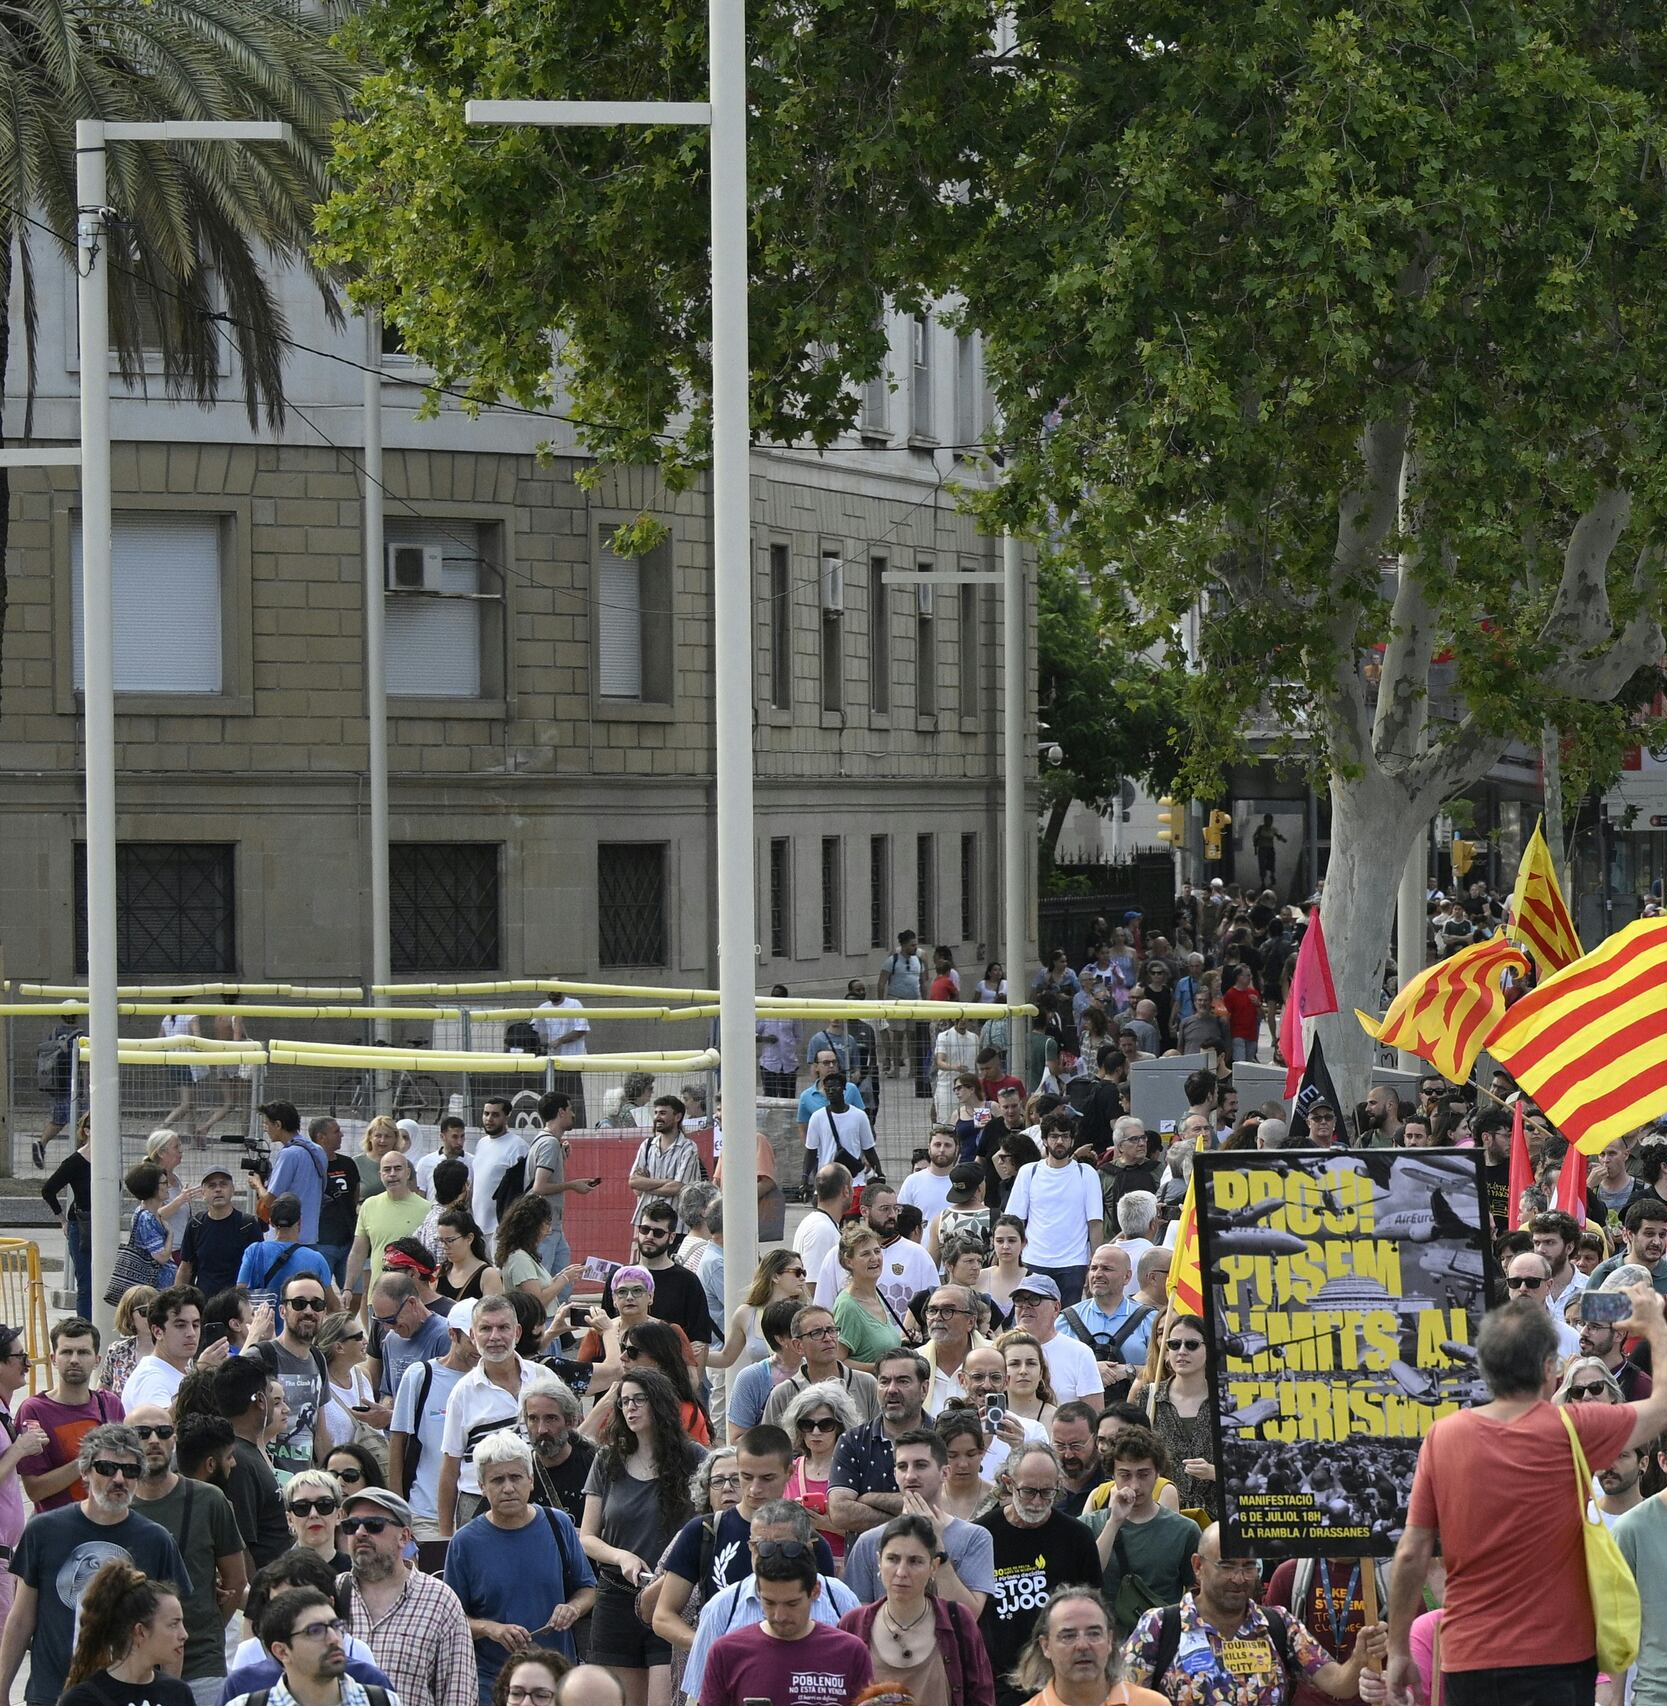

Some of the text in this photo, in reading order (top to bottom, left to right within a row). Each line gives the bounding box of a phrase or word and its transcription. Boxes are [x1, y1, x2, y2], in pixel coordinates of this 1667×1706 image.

[1238, 1492, 1314, 1507] MANIFESTACIÓ
[1239, 1511, 1322, 1523] 6 DE JULIOL 18H
[1241, 1527, 1254, 1539] LA
[1256, 1527, 1301, 1539] RAMBLA
[1309, 1526, 1371, 1540] DRASSANES
[992, 1576, 1047, 1596] STOP
[1315, 1587, 1348, 1599] FAKE
[996, 1590, 1051, 1615] JJOO
[1222, 1640, 1268, 1651] TOURISM
[1223, 1651, 1247, 1661] KILLS
[1230, 1662, 1253, 1673] CITY
[792, 1674, 844, 1689] POBLENOU
